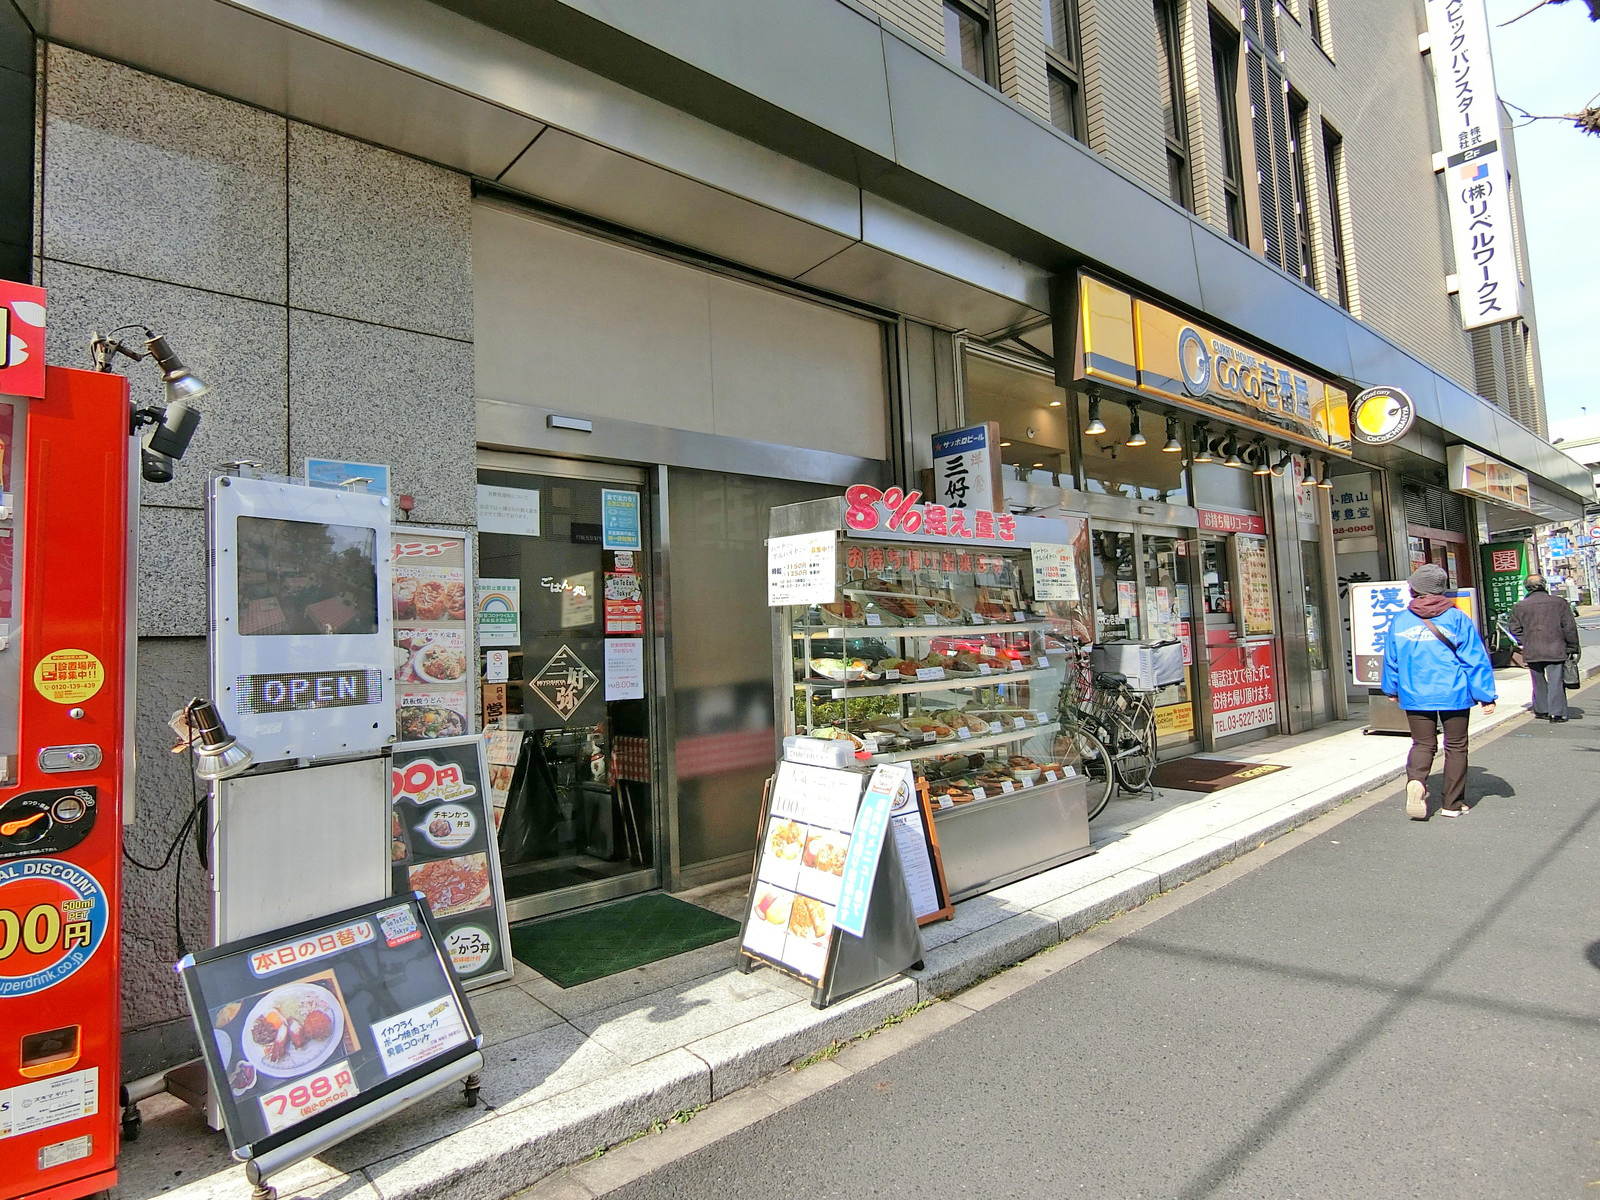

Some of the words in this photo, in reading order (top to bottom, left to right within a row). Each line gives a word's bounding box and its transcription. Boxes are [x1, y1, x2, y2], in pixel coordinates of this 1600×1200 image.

[1464, 149, 1480, 160] 2F
[1461, 181, 1502, 316] (株)リベルワークス
[943, 433, 985, 449] サッポロビール
[845, 484, 1017, 542] 8%据え置き
[1203, 511, 1259, 532] お持ち帰りコーナー
[540, 576, 587, 597] ごはん処
[57, 661, 97, 672] 設置場所
[57, 671, 97, 681] 募集中!!
[1210, 664, 1272, 689] 電話注文で待たずに
[51, 683, 96, 691] 0120-139-439
[263, 676, 357, 705] OPEN
[1212, 684, 1272, 710] お持ち帰り頂けます。
[434, 811, 469, 819] チキンかつ
[456, 820, 471, 828] 弁当
[23, 863, 98, 896] DISCOUNT
[62, 898, 95, 912] 500ml
[68, 910, 90, 921] PET
[253, 922, 372, 971] 本日の日替り
[450, 933, 482, 945] ソース
[458, 942, 490, 955] かつ丼
[381, 1018, 413, 1038] イカフライ
[383, 1018, 440, 1048] ポーク焼肉エッグ
[264, 1069, 353, 1116] 788円
